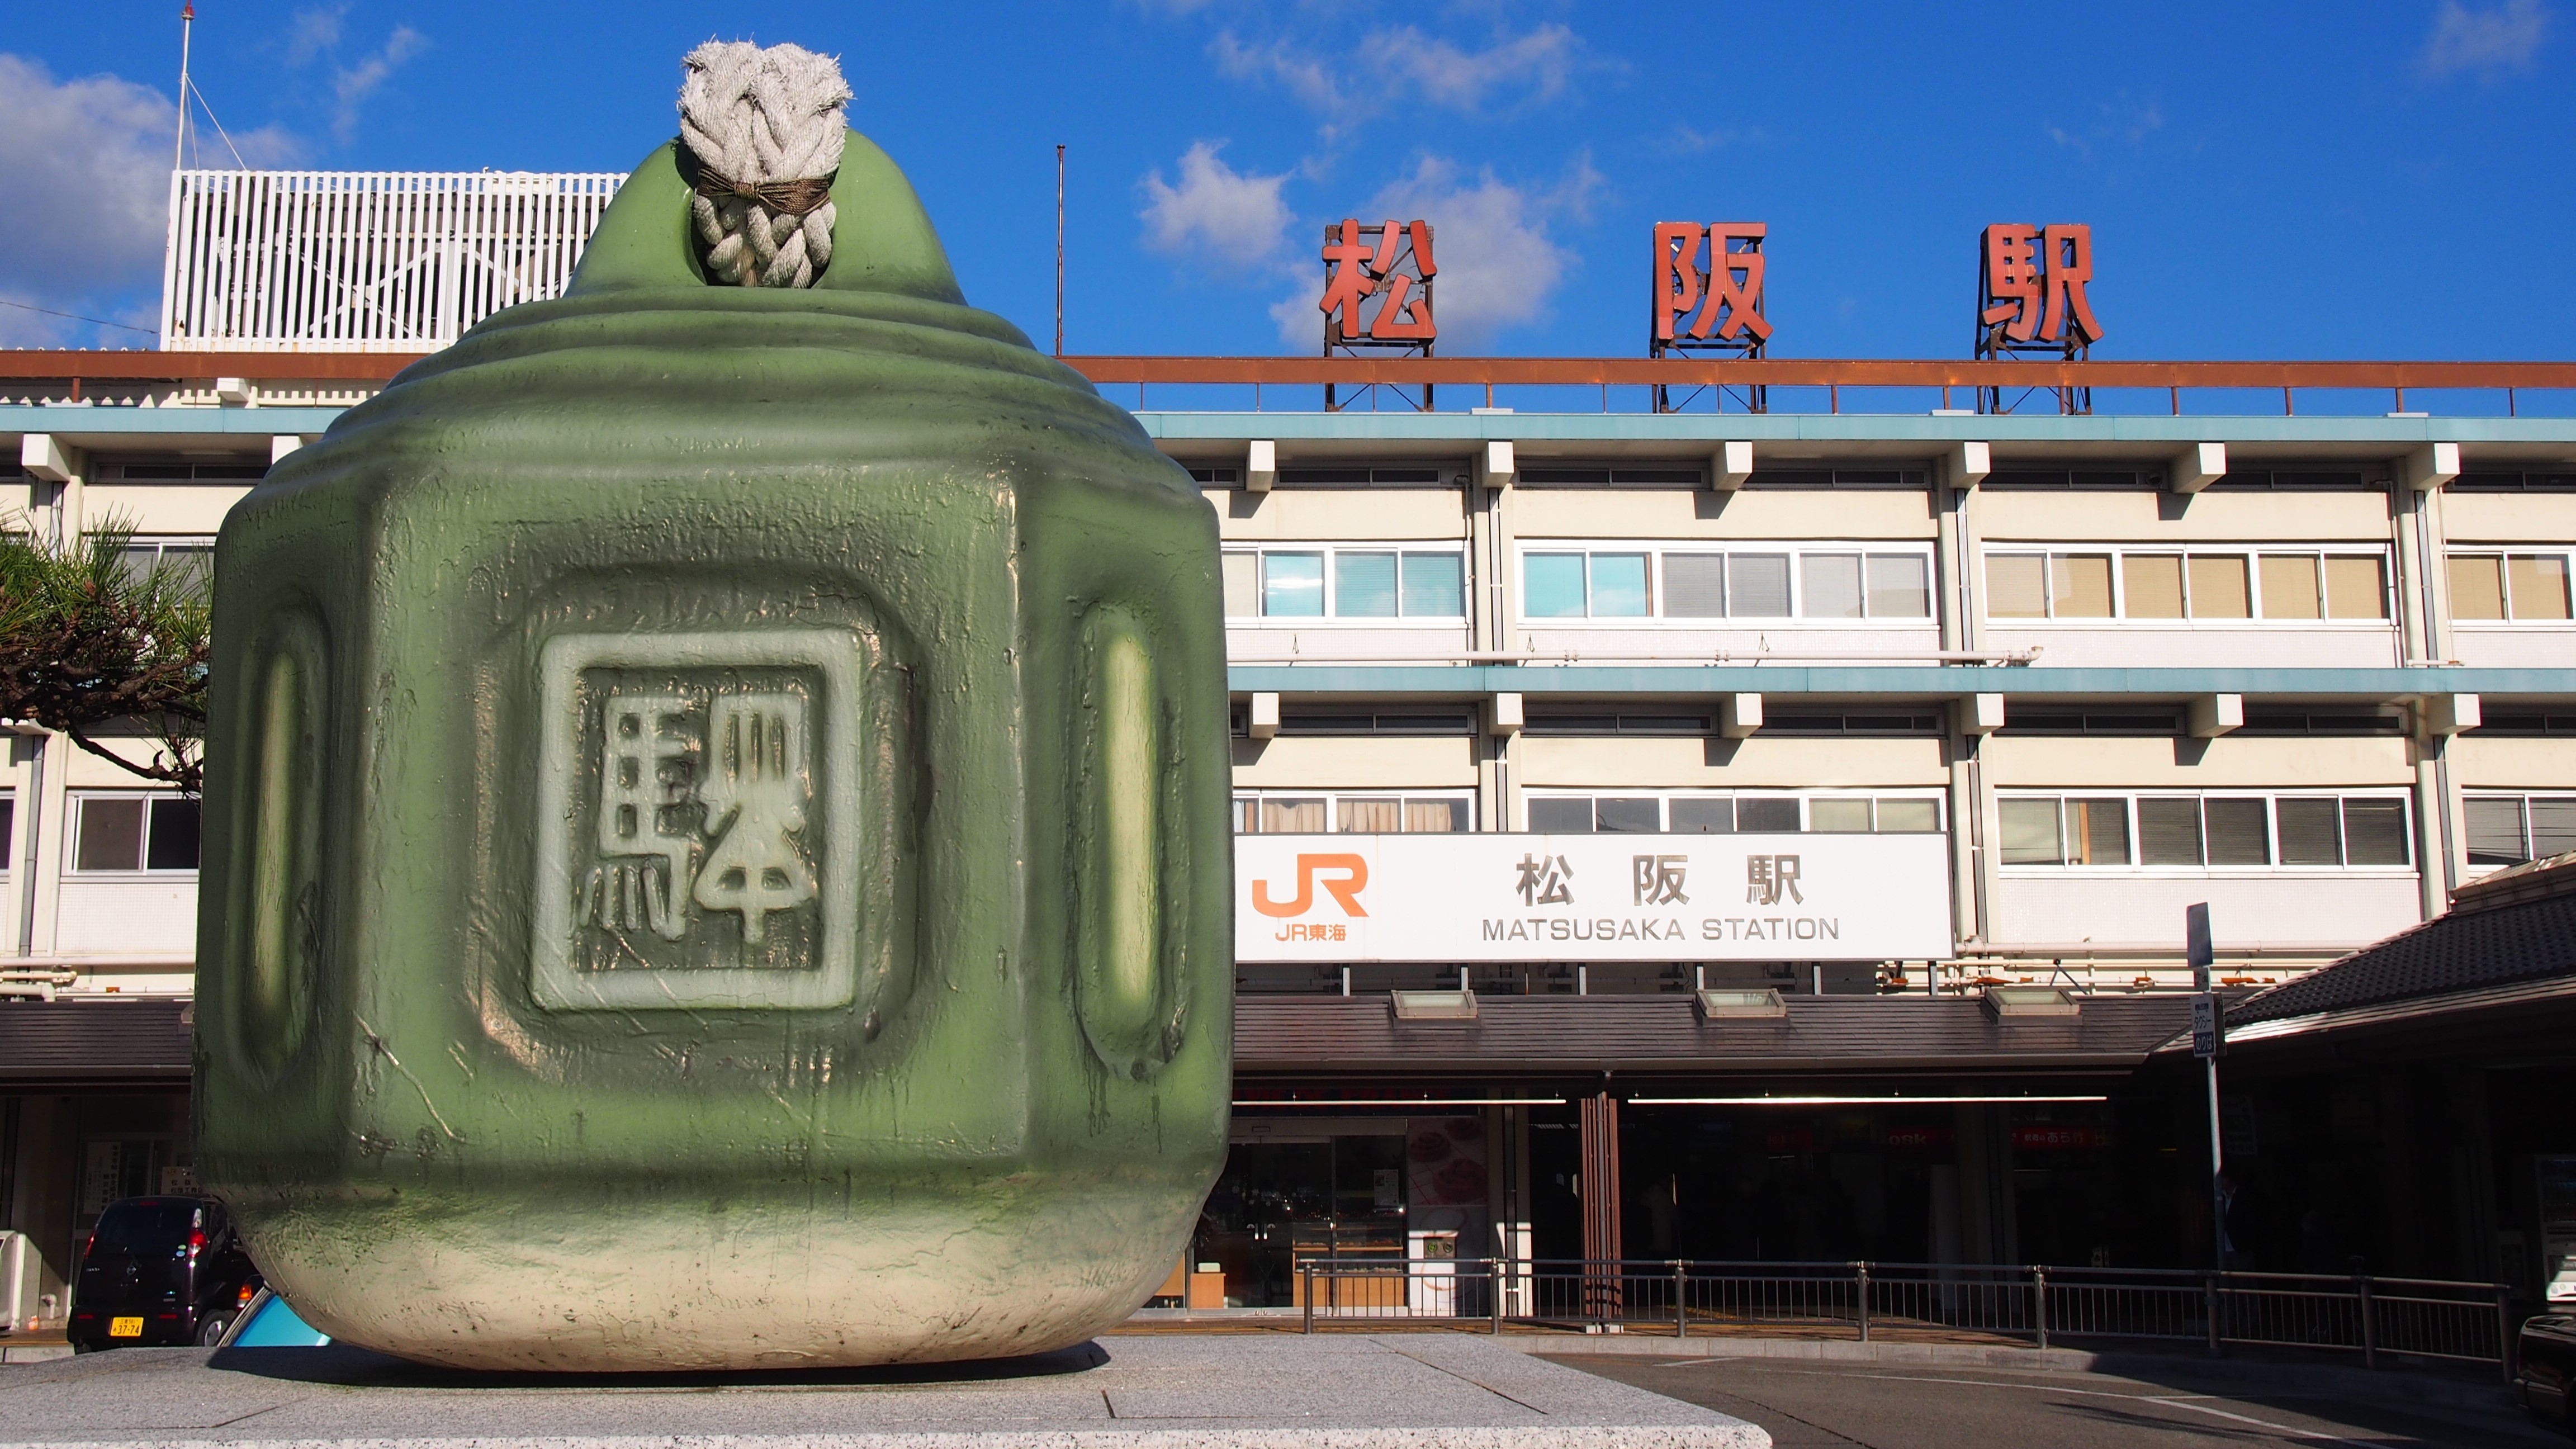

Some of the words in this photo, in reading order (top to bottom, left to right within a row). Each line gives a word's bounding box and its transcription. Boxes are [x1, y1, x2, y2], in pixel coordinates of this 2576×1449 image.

[1252, 854, 1369, 917] JR
[1516, 853, 1805, 907] 松阪駅
[1275, 924, 1346, 941] JR東海
[1483, 918, 1683, 941] MATSUSAKA
[1702, 917, 1839, 940] STATION
[2194, 1015, 2212, 1029] タクシー
[2195, 1035, 2213, 1050] のりば
